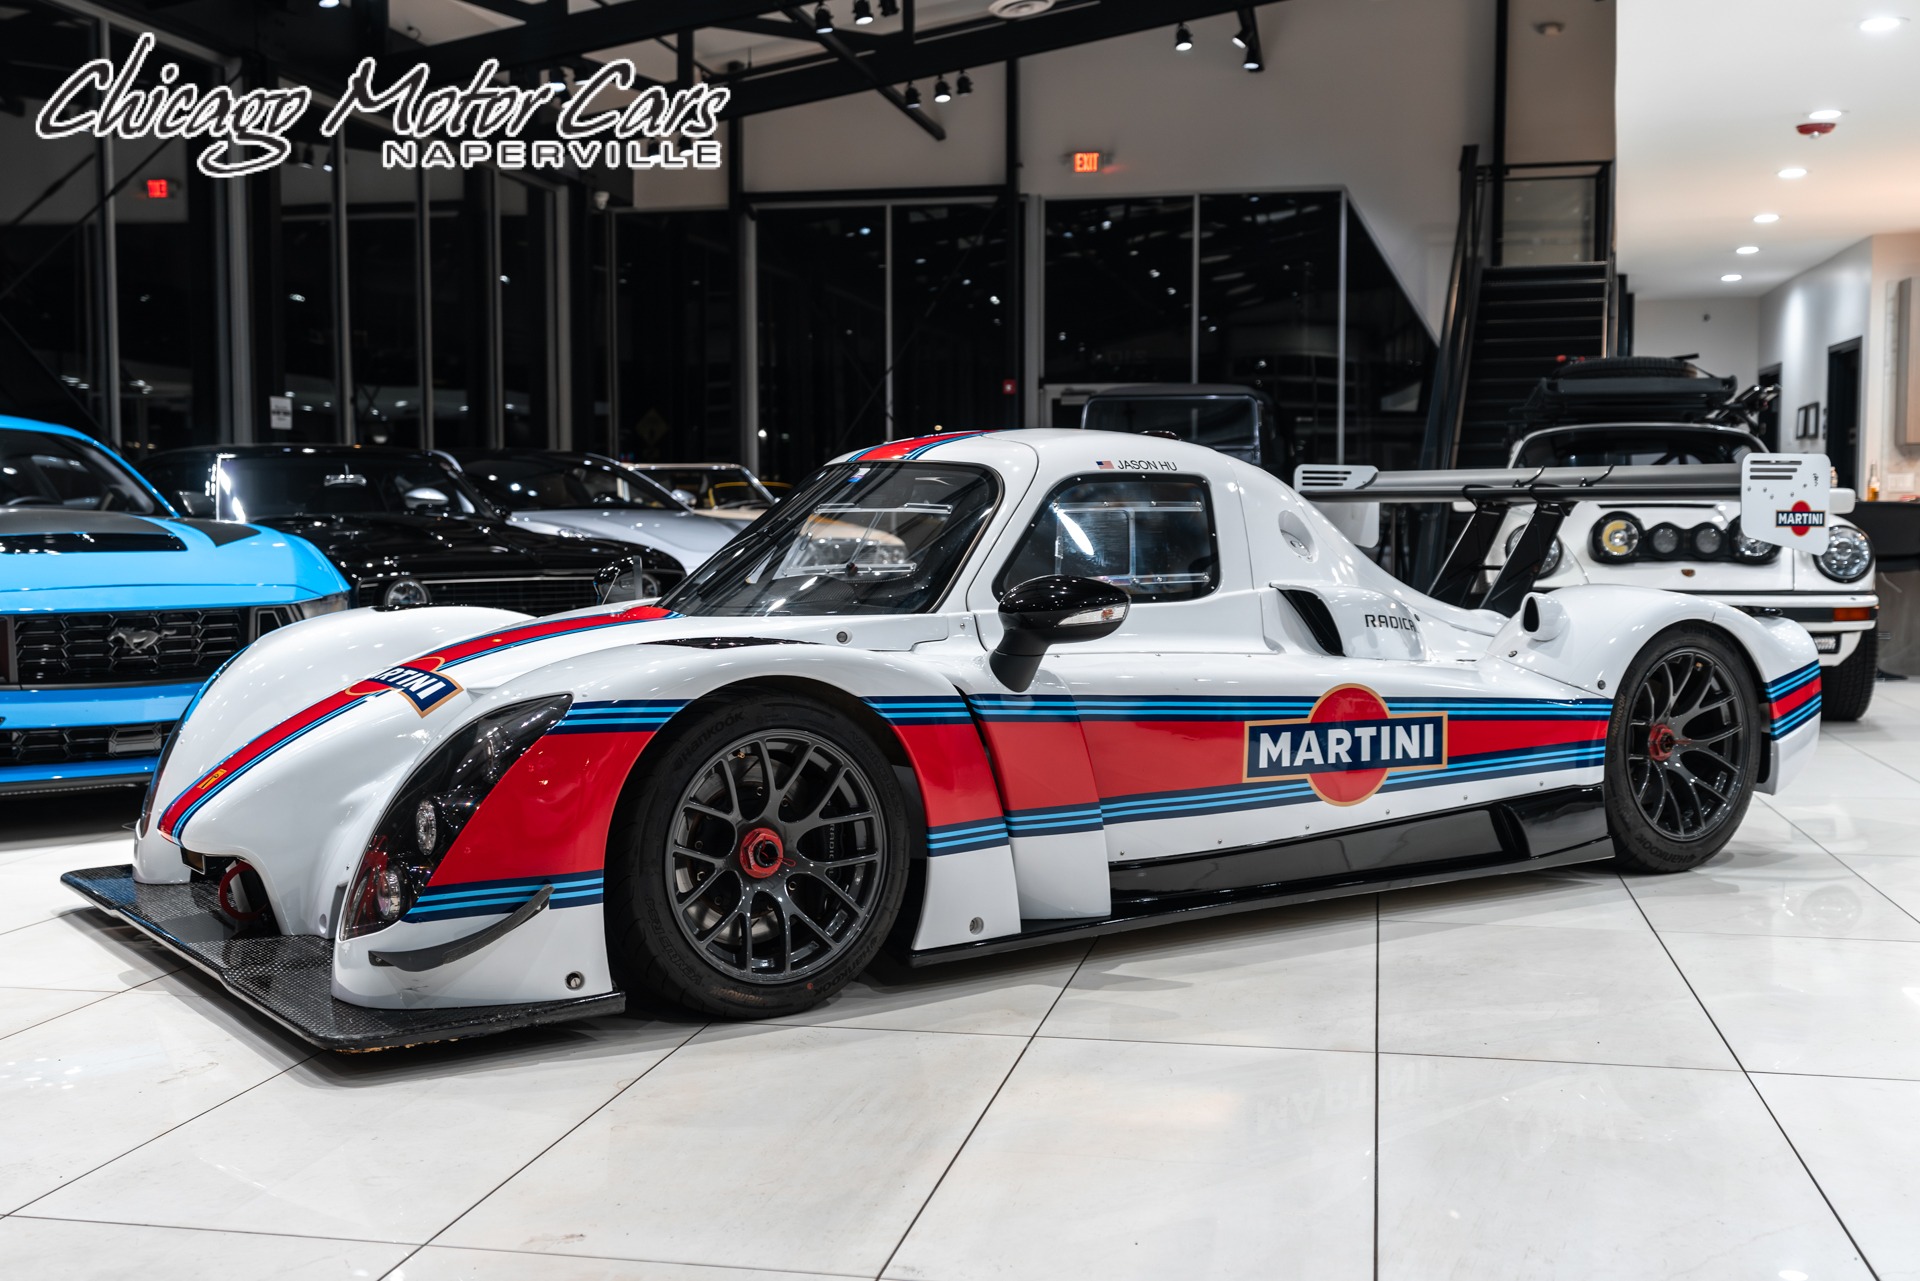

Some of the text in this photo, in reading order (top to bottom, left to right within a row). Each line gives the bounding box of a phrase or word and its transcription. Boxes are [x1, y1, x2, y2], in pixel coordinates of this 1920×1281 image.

[1074, 152, 1100, 173] EXIT
[1117, 459, 1178, 472] JASON HU
[1777, 512, 1824, 525] MARTINI
[1364, 614, 1419, 634] RADICA
[368, 667, 447, 700] RTINI
[1258, 723, 1434, 769] MARTINI
